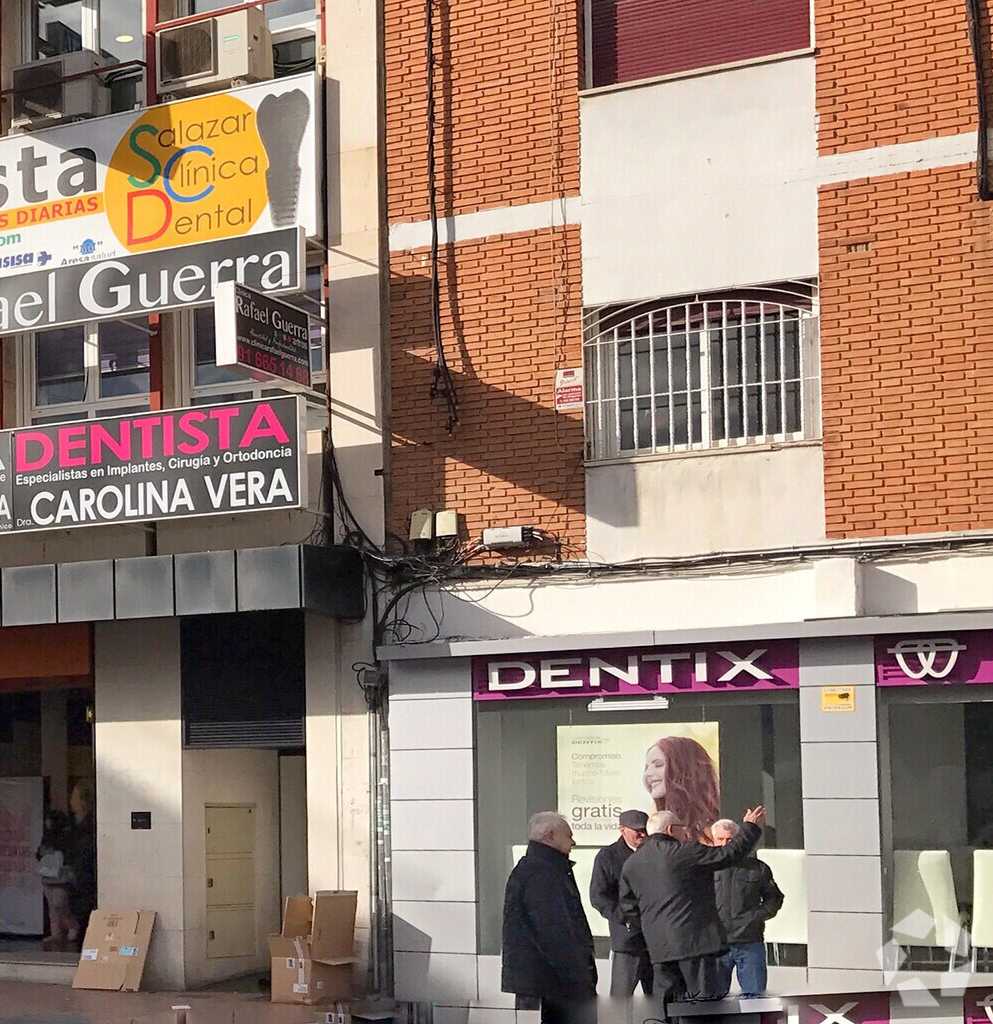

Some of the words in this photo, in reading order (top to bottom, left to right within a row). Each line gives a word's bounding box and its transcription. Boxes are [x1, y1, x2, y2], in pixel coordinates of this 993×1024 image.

[127, 111, 252, 188] Salazar
[163, 145, 258, 202] Clínica
[16, 196, 98, 224] DIARIAS
[127, 189, 252, 246] Dental
[78, 248, 290, 315] Guerra
[235, 295, 269, 325] Rafael
[271, 310, 308, 341] Guerra
[15, 403, 290, 472] DENTISTA
[16, 466, 88, 486] Especialistas
[90, 468, 105, 477] en
[107, 460, 166, 478] Implantes,
[168, 455, 210, 472] Cirugía
[213, 456, 220, 469] y
[223, 447, 292, 463] Ortodoncia
[17, 517, 34, 527] Dra.
[30, 478, 195, 526] CAROLINA
[204, 468, 294, 509] VERA
[488, 648, 774, 691] DENTIX
[571, 795, 622, 804] Revisiones
[571, 804, 622, 821] gratis
[571, 823, 592, 831] toda
[594, 823, 602, 831] la
